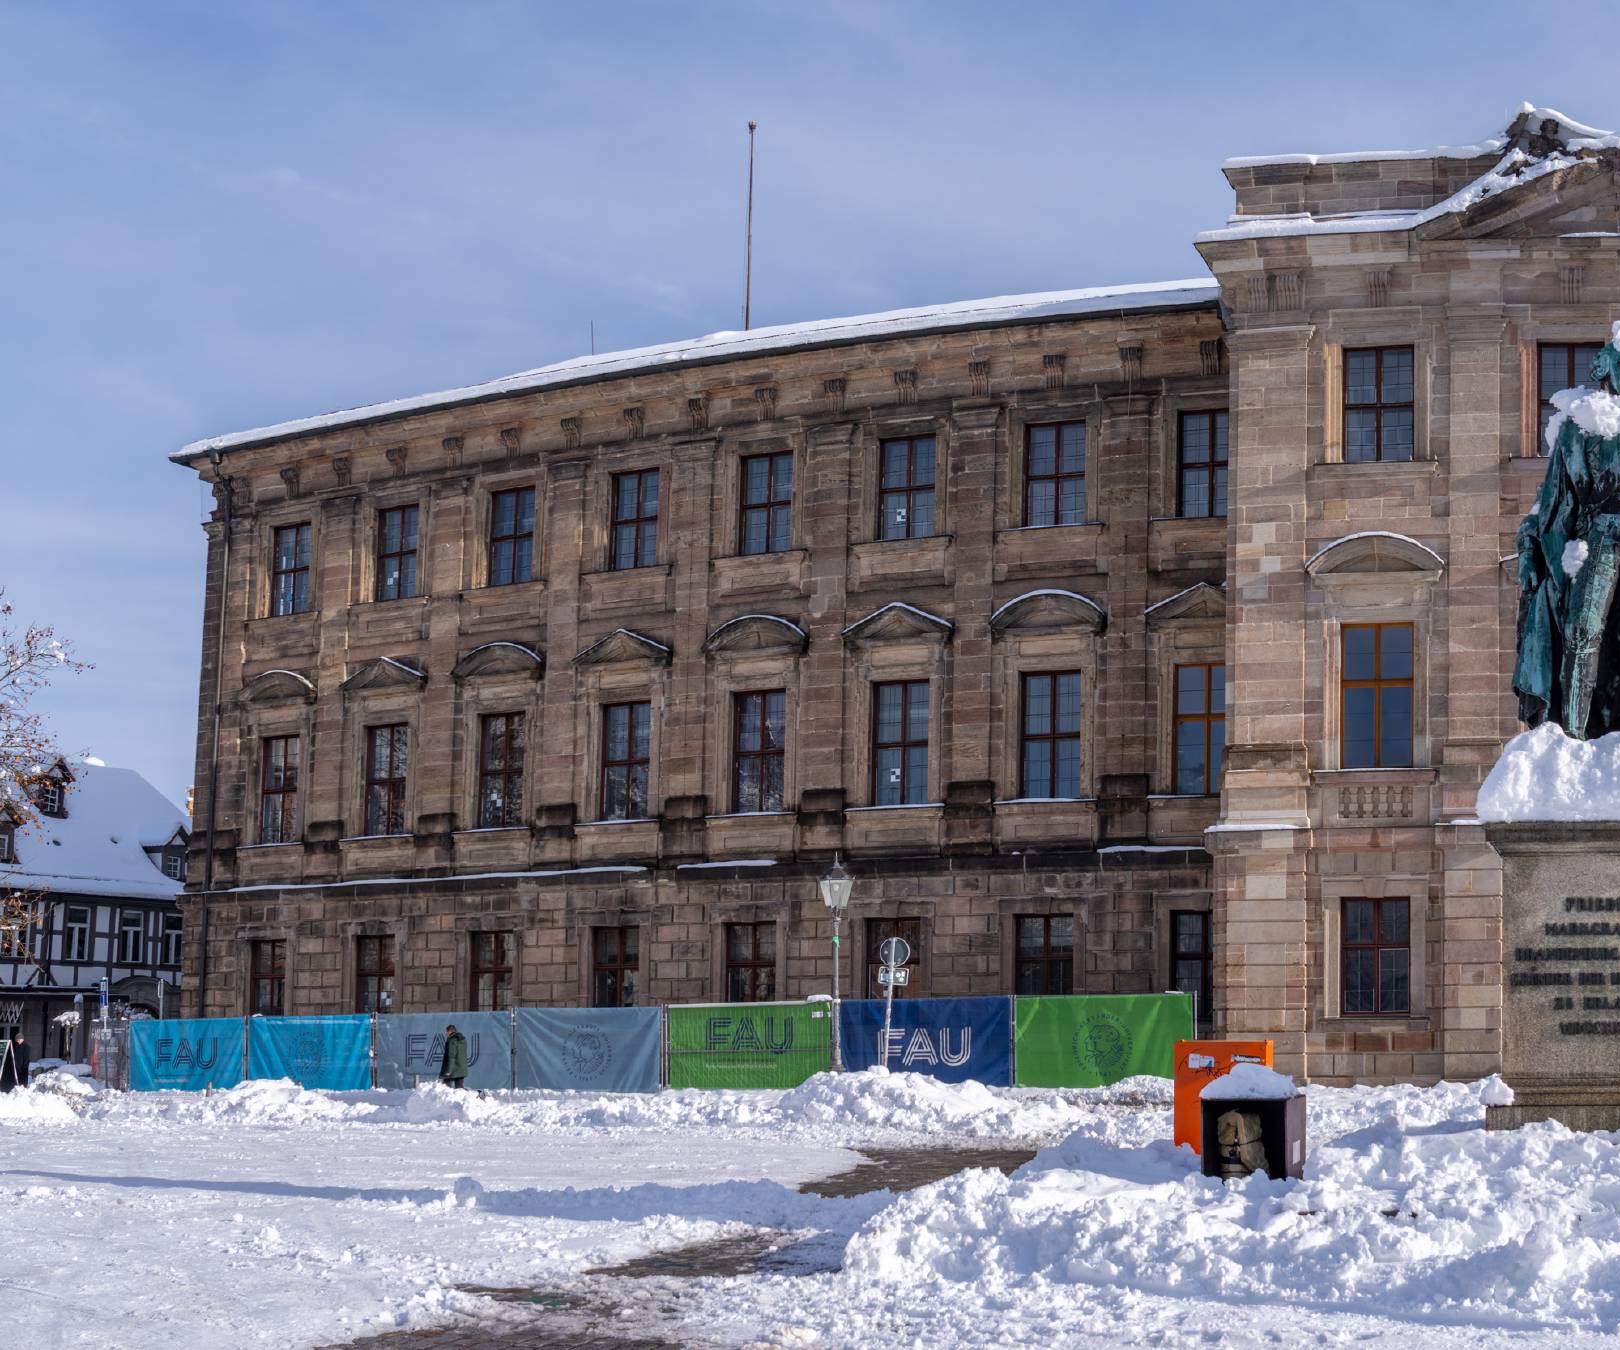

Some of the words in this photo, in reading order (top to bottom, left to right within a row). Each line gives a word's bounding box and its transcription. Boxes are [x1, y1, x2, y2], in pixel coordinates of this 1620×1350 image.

[155, 1037, 218, 1070] FAU
[705, 1016, 794, 1054] FAU
[877, 1026, 971, 1067] FAU
